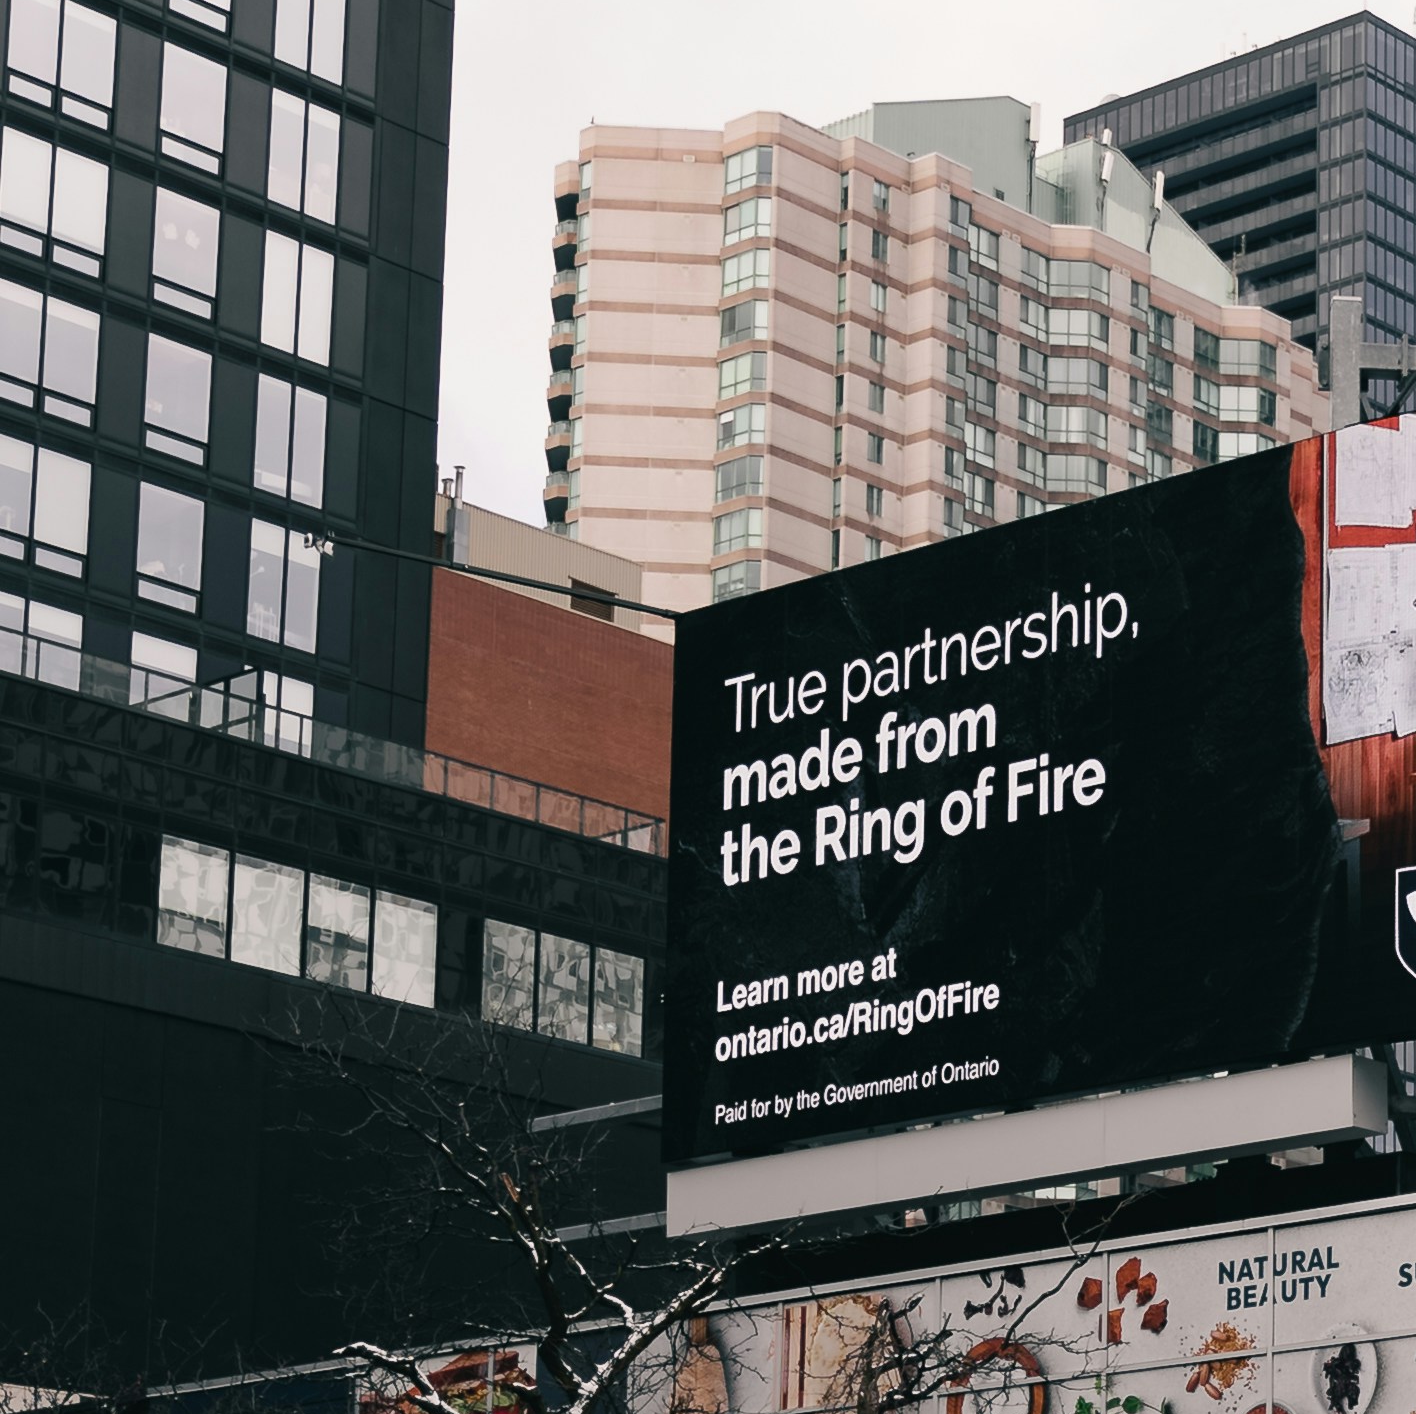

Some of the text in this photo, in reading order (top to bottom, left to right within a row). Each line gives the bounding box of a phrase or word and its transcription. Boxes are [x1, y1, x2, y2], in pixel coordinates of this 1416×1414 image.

[725, 583, 1140, 733] True partnership,
[722, 703, 997, 810] made from
[721, 753, 1107, 887] the Ring of Fire
[716, 947, 898, 1013] Learn more at
[715, 981, 1000, 1062] ontario.ca/RingOfFire
[715, 1056, 1000, 1126] Paid for by the Government of Ontario
[1218, 1246, 1340, 1285] NATURAL
[1226, 1273, 1332, 1311] BEAUTY
